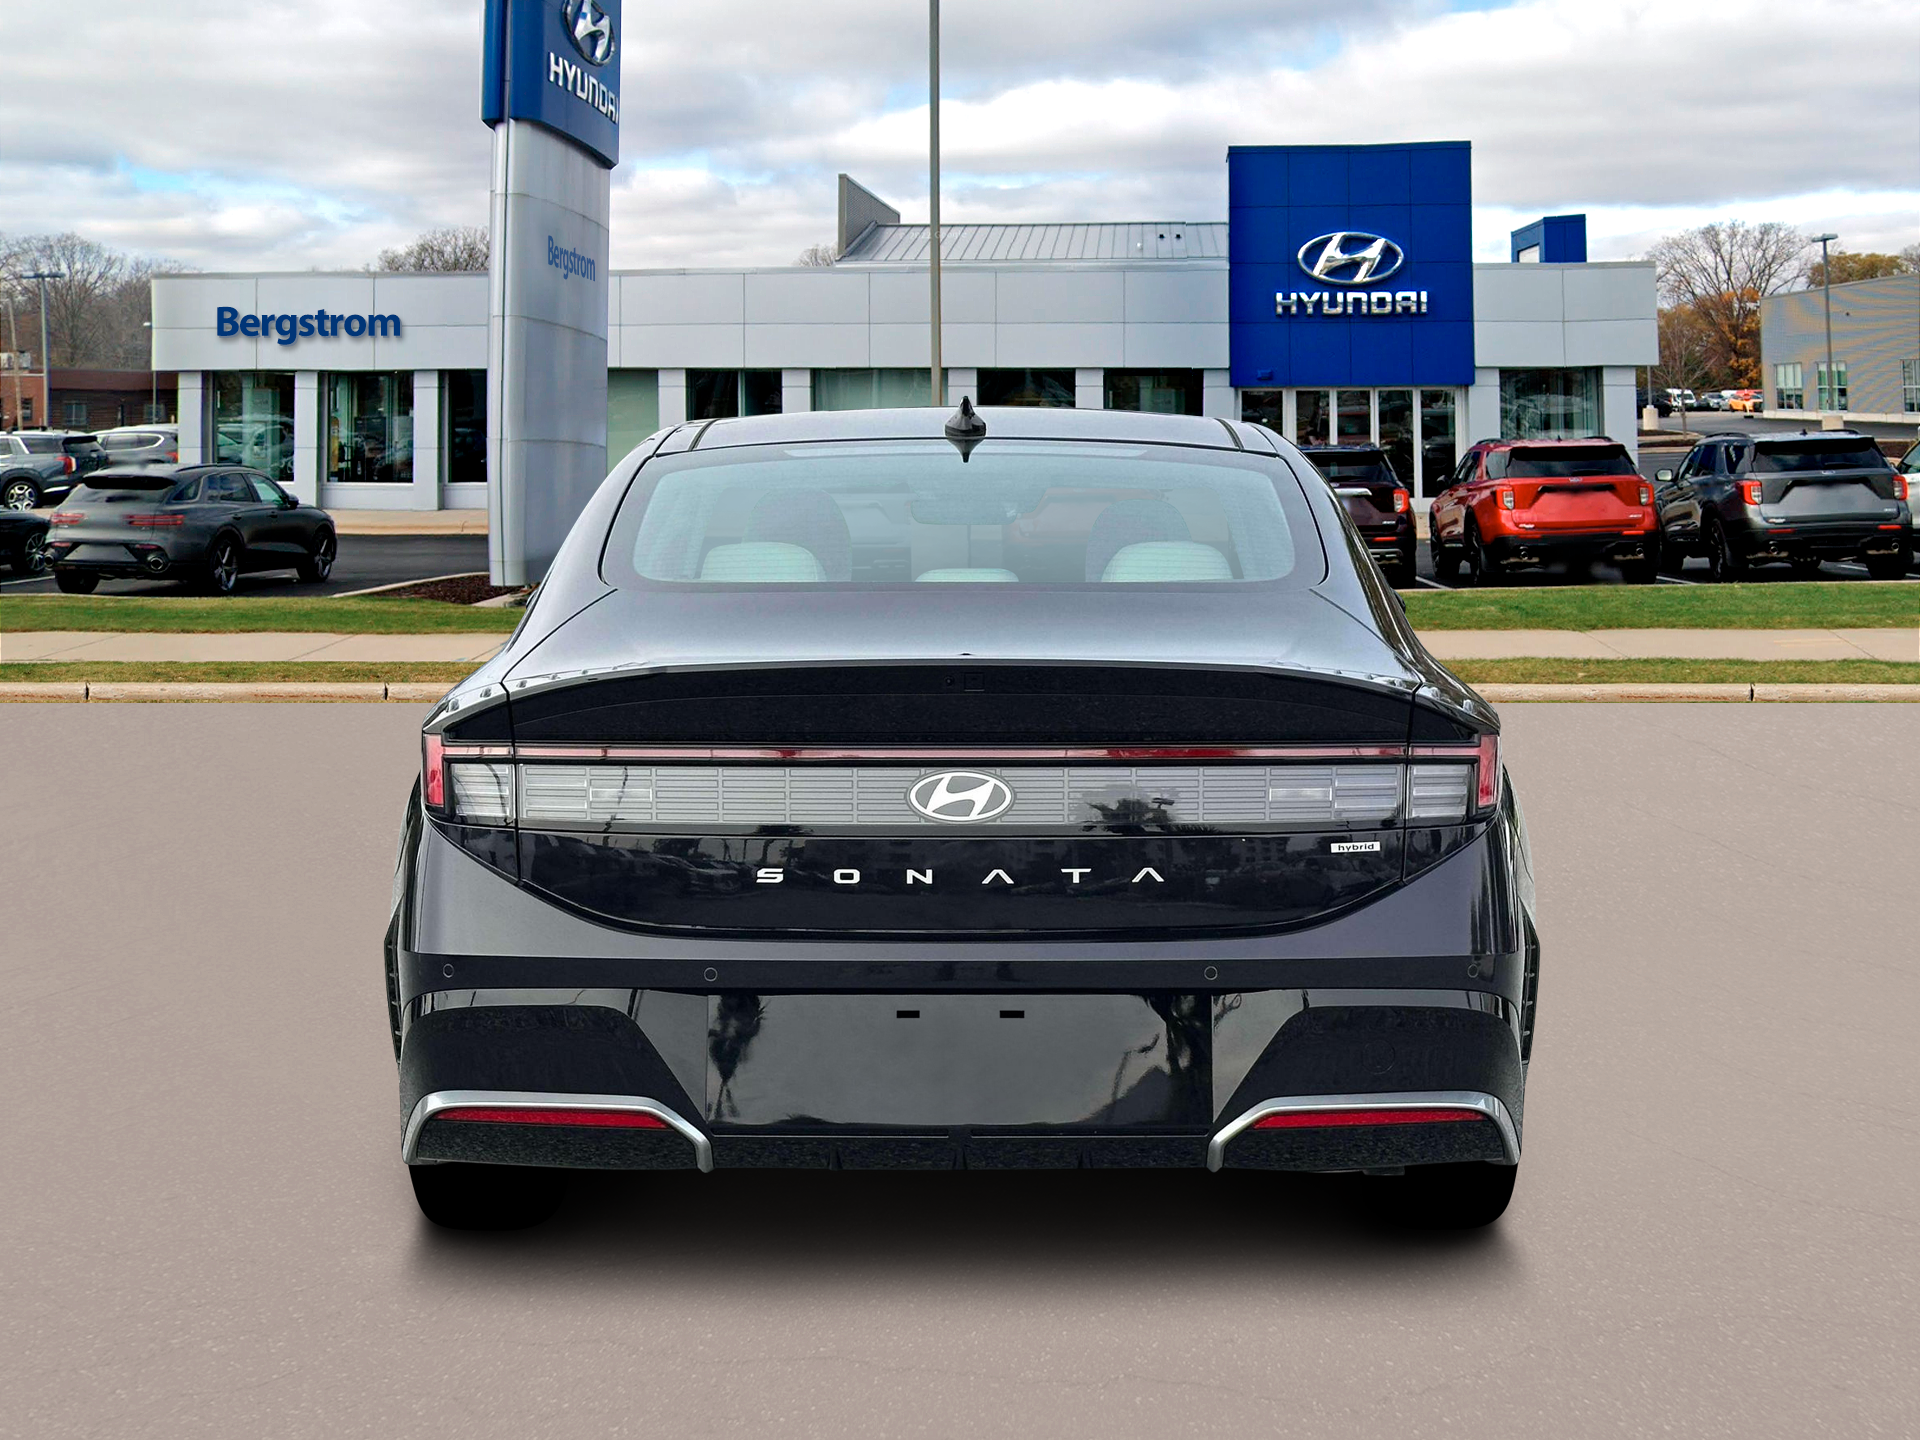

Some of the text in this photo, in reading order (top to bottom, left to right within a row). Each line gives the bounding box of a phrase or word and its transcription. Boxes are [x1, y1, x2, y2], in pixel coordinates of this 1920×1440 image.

[549, 52, 619, 124] HYUNDAI
[547, 235, 596, 282] Bergstrom
[1275, 291, 1428, 315] HYUNDAI
[217, 306, 401, 346] Bergstrom
[1338, 843, 1375, 852] hybrid
[756, 867, 1165, 885] SONATA
